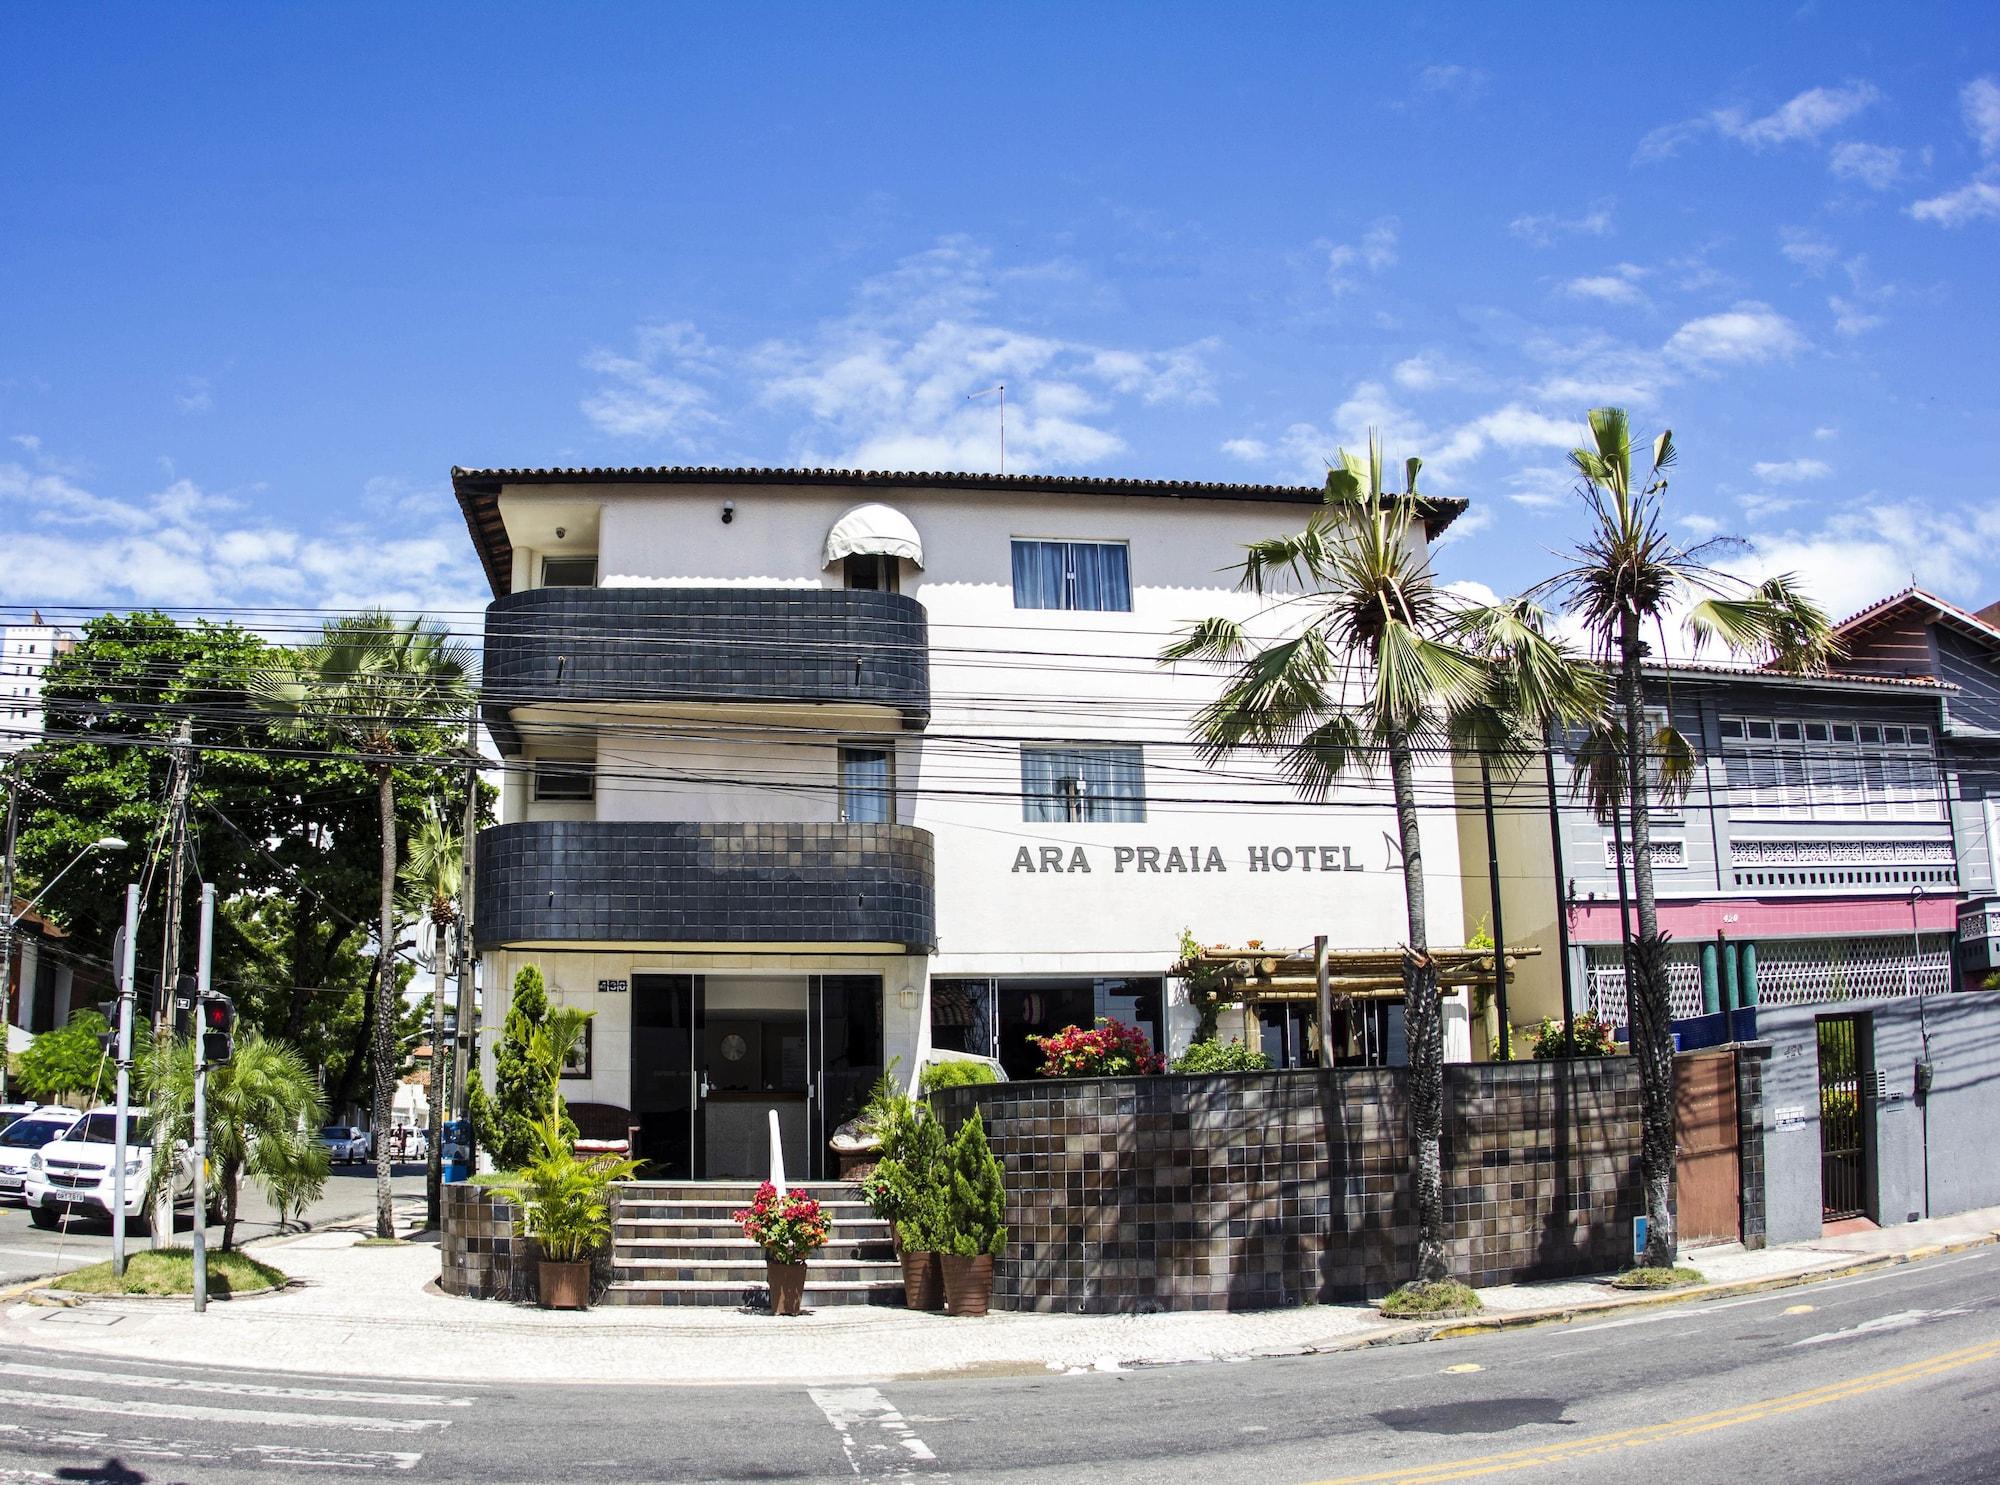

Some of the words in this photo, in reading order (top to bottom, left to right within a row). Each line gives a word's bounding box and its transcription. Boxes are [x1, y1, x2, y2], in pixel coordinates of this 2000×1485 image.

[1011, 846, 1092, 873] ARA
[1113, 846, 1227, 873] PRAIA
[1247, 846, 1364, 872] HOTEL
